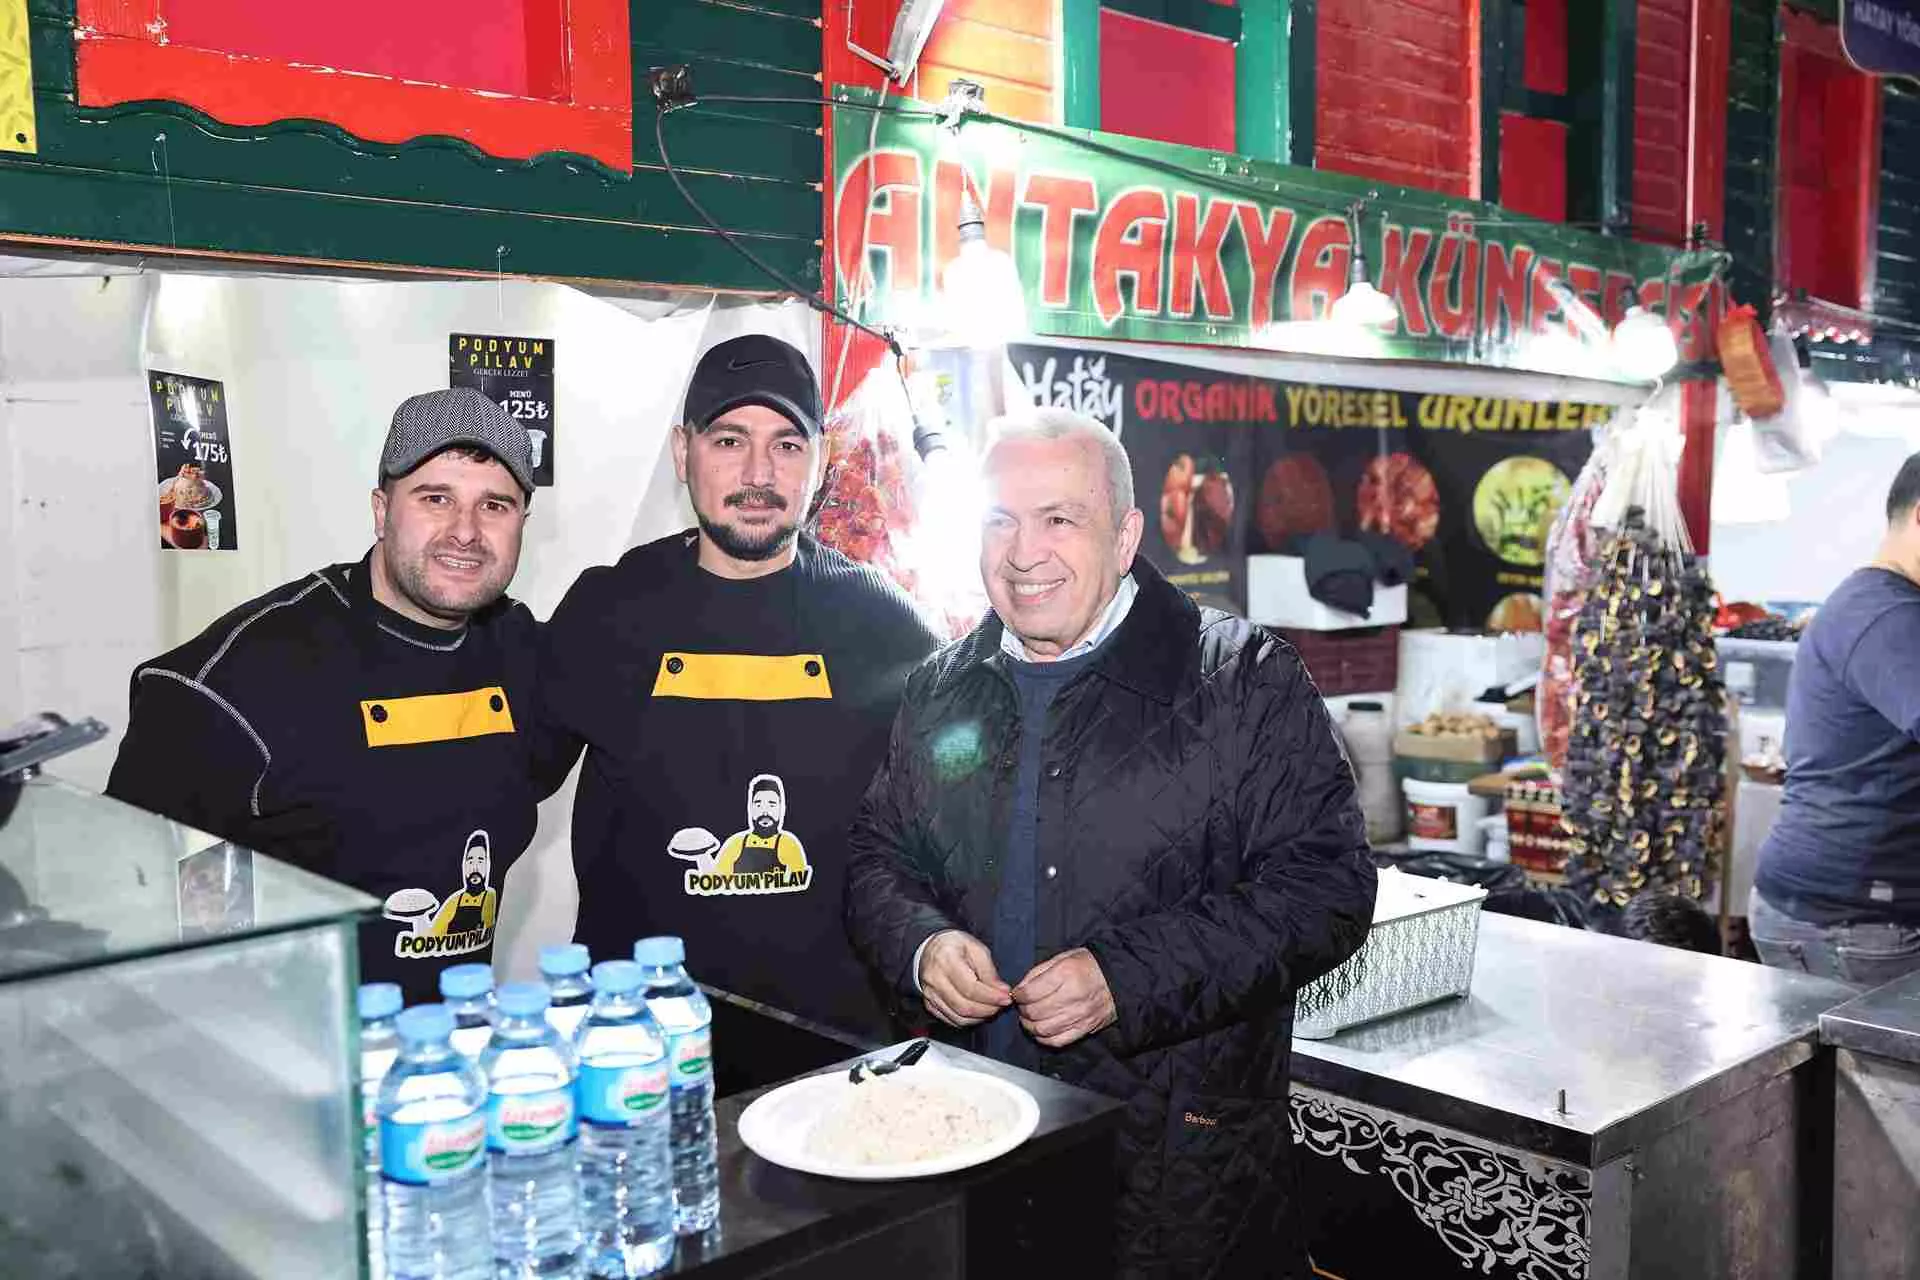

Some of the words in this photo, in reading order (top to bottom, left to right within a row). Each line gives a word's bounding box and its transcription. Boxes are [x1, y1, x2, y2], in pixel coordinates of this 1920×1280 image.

[836, 150, 1352, 328] ANTAKYA
[459, 338, 543, 355] PODYUM
[470, 352, 532, 369] PİLAV
[1023, 355, 1124, 443] Hatay
[499, 400, 549, 419] 125₺
[192, 441, 228, 463] 175₺
